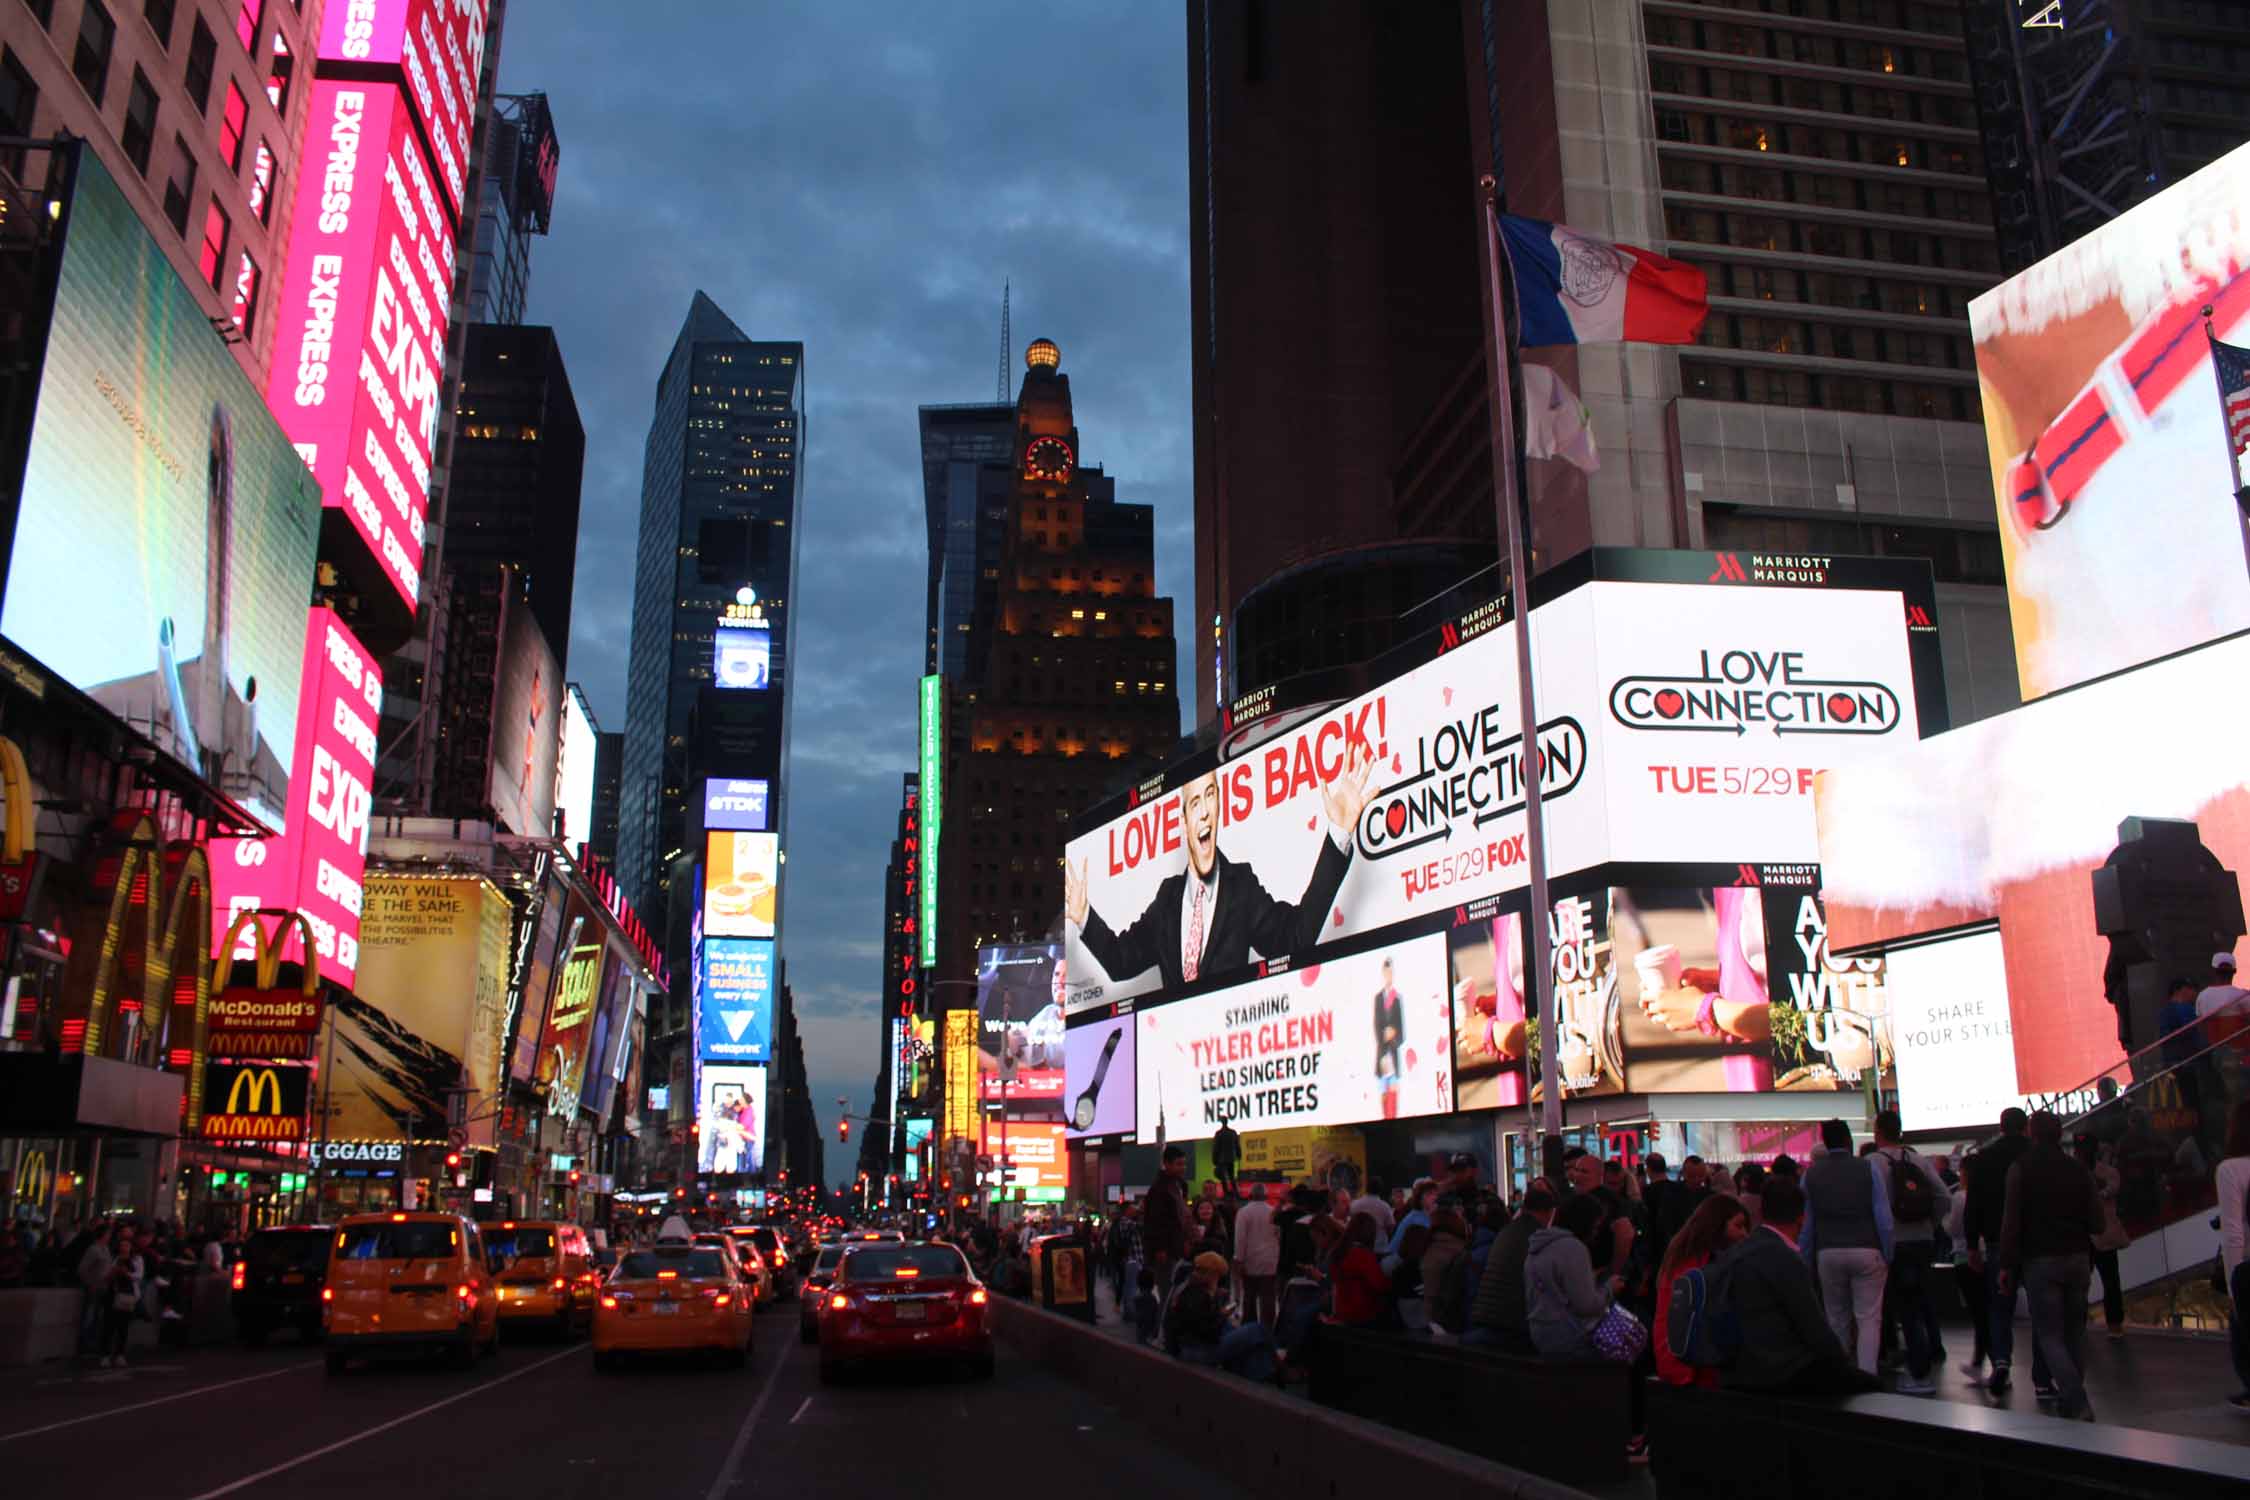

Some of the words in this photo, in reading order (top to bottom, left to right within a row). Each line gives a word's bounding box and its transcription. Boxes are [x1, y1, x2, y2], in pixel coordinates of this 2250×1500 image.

[341, 0, 377, 58] ESS
[318, 90, 366, 234] EXPRESS
[403, 132, 443, 241] EXPRESS
[390, 233, 432, 337] EXPRESS
[294, 254, 343, 407] EXPRESS
[370, 265, 440, 462] EXPR
[365, 427, 411, 521] EXPRESS
[1752, 555, 1831, 568] MARRIOTT
[1753, 569, 1825, 583] MARQUIS
[1461, 596, 1507, 628] MARRIOTT
[1461, 611, 1503, 641] MARQUIS
[1701, 649, 1804, 686] LOVE
[1233, 685, 1276, 713] MARRIOTT
[1233, 701, 1271, 726] MARQUIS
[1624, 688, 1887, 724] CONNECTION
[1418, 704, 1499, 777] LOVE
[1108, 795, 1181, 878] LOVE
[1222, 763, 1253, 828] IS
[1264, 695, 1389, 809] BACK!
[1648, 766, 1718, 794] TUE
[1723, 767, 1791, 795] 5/29
[1401, 862, 1440, 900] TUE
[1442, 847, 1485, 886] 5/29
[1487, 832, 1528, 872] FOX
[1763, 864, 1818, 876] MARRIOTT
[1763, 874, 1813, 886] MARQUIS
[383, 898, 413, 912] THE
[417, 900, 464, 913] SAME.
[415, 884, 454, 898] WILL
[383, 914, 424, 924] MARVEL
[427, 915, 454, 924] THAT
[709, 962, 767, 978] SMALL
[208, 1001, 315, 1016] McDonald's
[224, 1016, 297, 1028] Restaurant
[1224, 993, 1290, 1029] STARRING
[1927, 1000, 1985, 1024] SHARE
[1190, 1029, 1253, 1069] TYLER
[1257, 1008, 1333, 1055] GLENN
[1904, 1027, 1953, 1049] YOUR
[1200, 1068, 1236, 1093] LEAD
[1239, 1057, 1296, 1087] SINGER
[1300, 1050, 1322, 1076] OF
[1204, 1092, 1251, 1124] NEON
[1256, 1082, 1319, 1117] TREES
